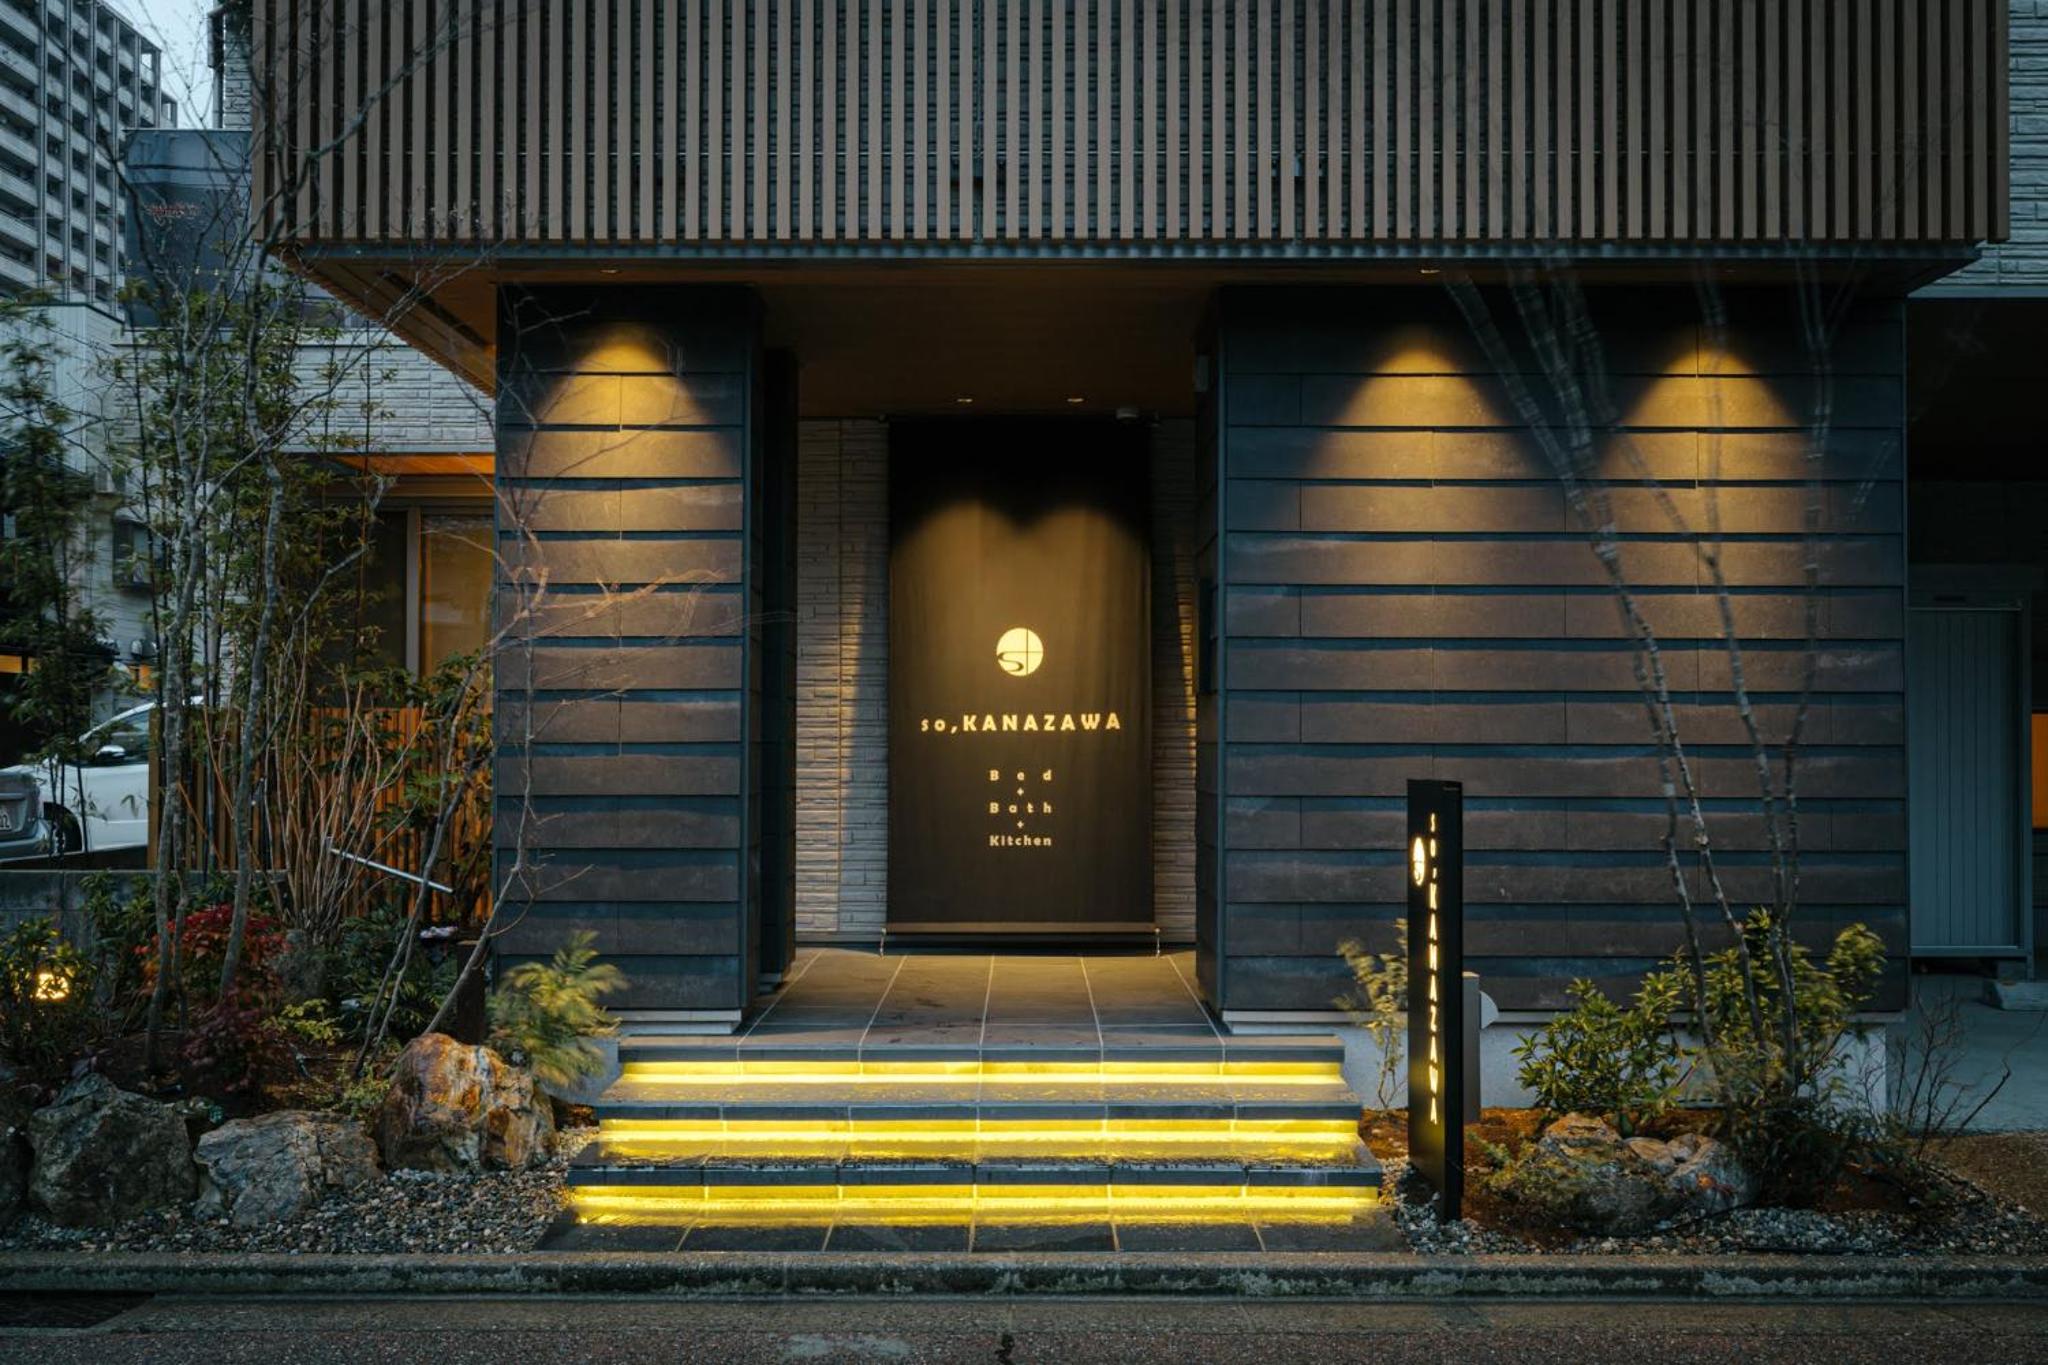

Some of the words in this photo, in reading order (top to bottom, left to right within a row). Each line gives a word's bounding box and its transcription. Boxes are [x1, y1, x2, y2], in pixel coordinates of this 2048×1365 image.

[989, 769, 1052, 781] Bed
[989, 802, 1052, 814] Bath
[989, 835, 1052, 847] Kitchen
